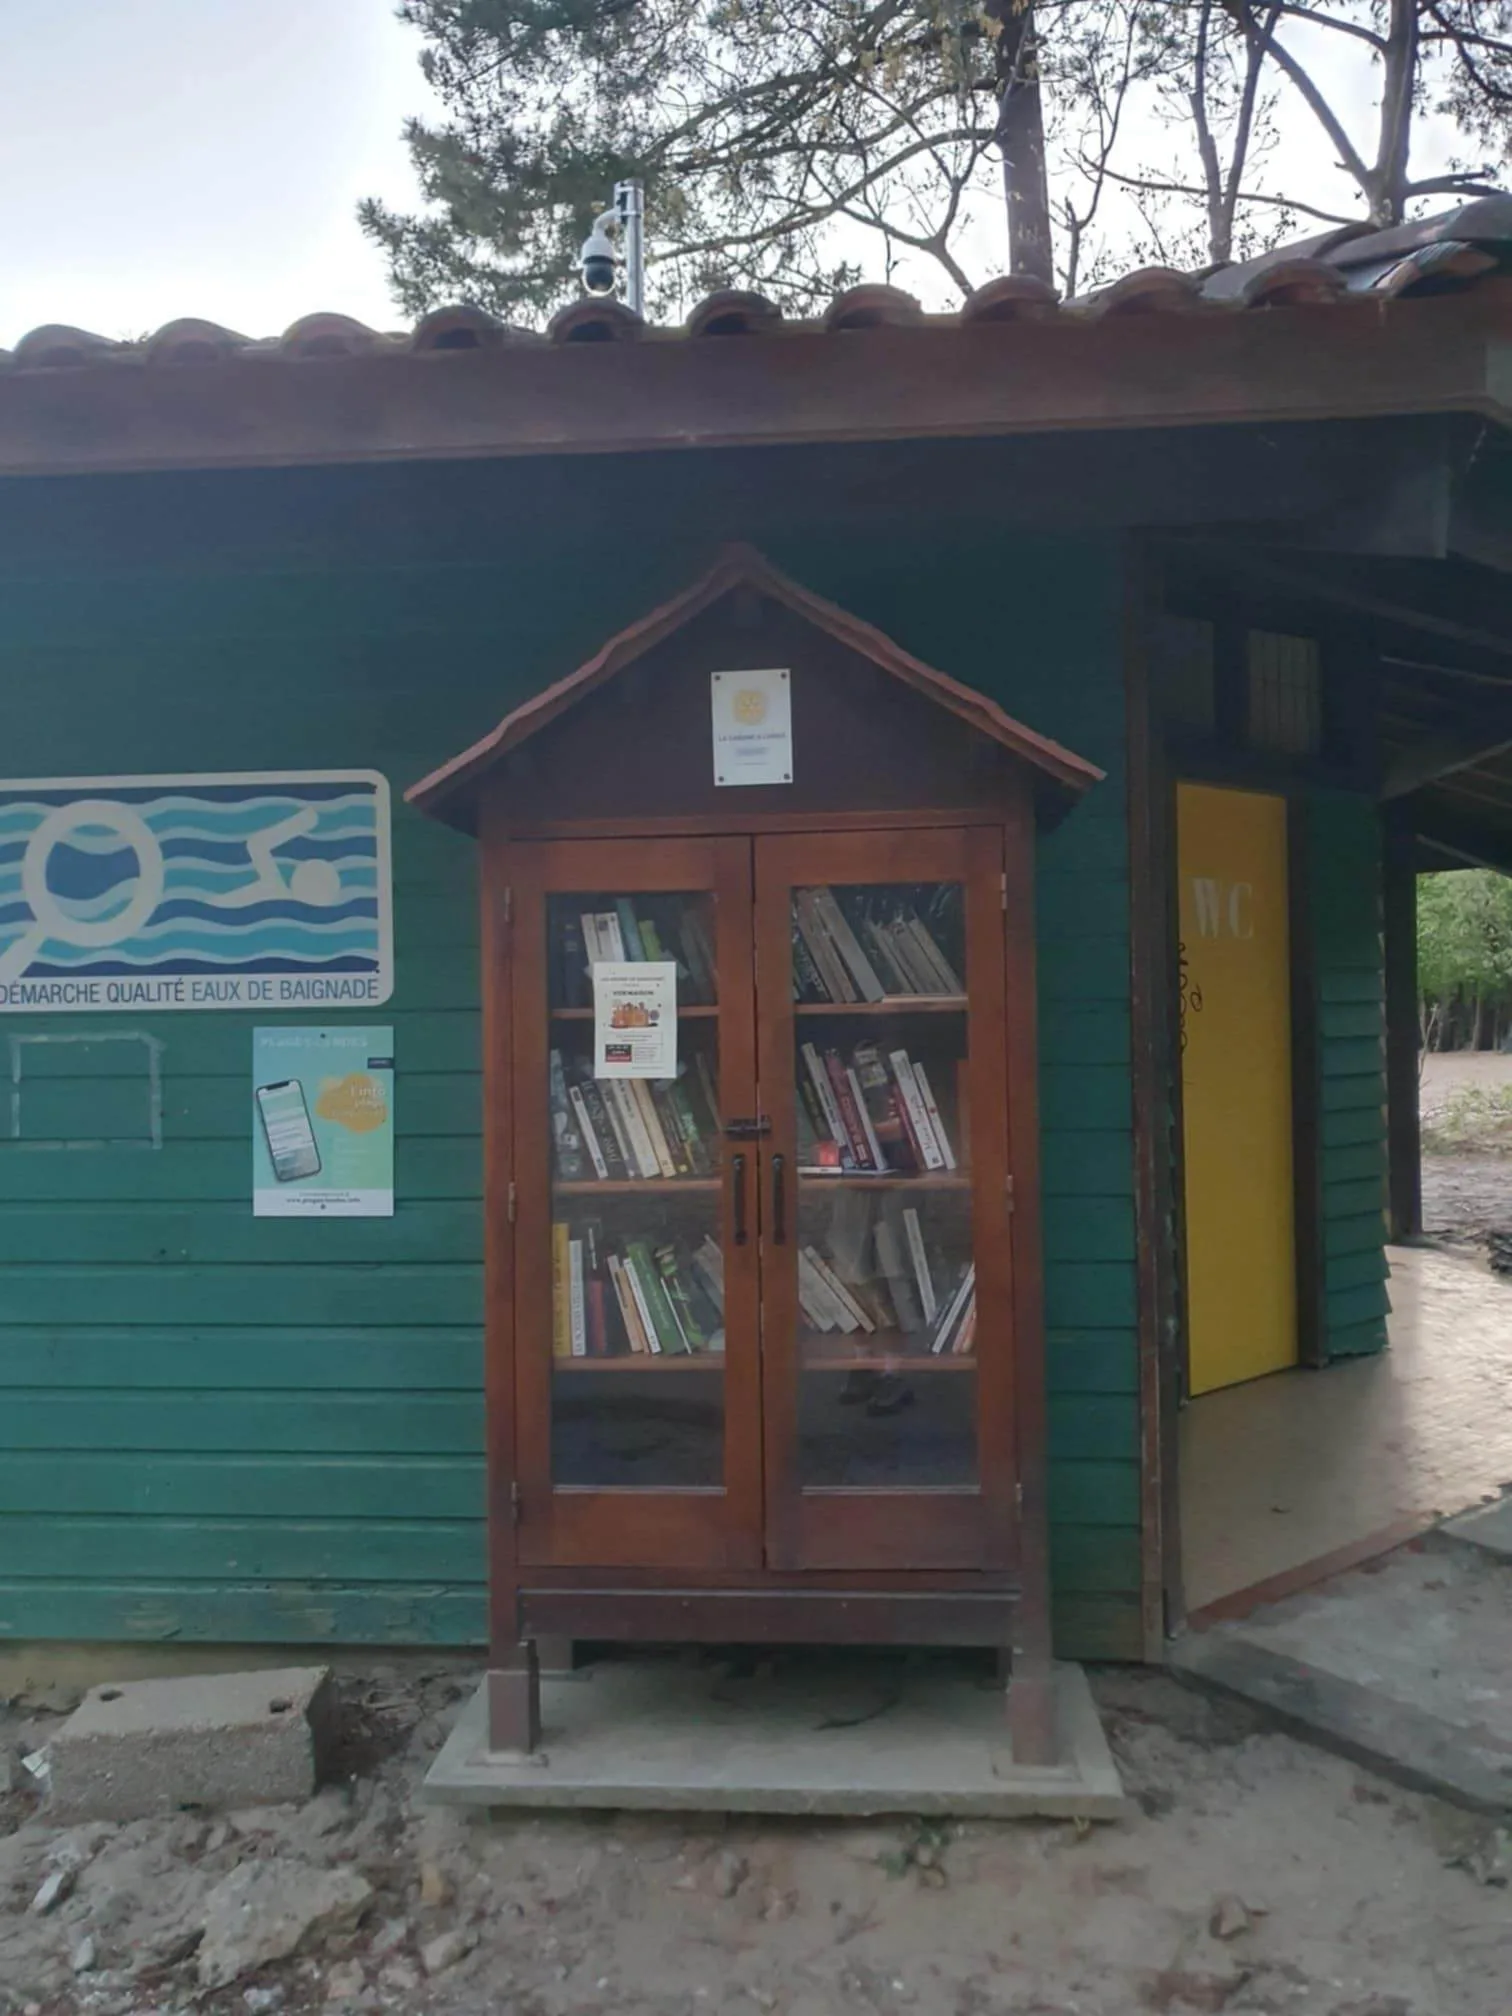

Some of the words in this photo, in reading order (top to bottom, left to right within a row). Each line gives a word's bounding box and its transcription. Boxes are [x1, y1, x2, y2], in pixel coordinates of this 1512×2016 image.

[1192, 877, 1254, 940] WC
[0, 980, 100, 1004] DÉMARCHE
[107, 978, 185, 1003] QUALITÉ
[192, 981, 241, 1001] EAUX
[248, 980, 273, 1000] DE
[280, 979, 379, 1000] BAIGNADE
